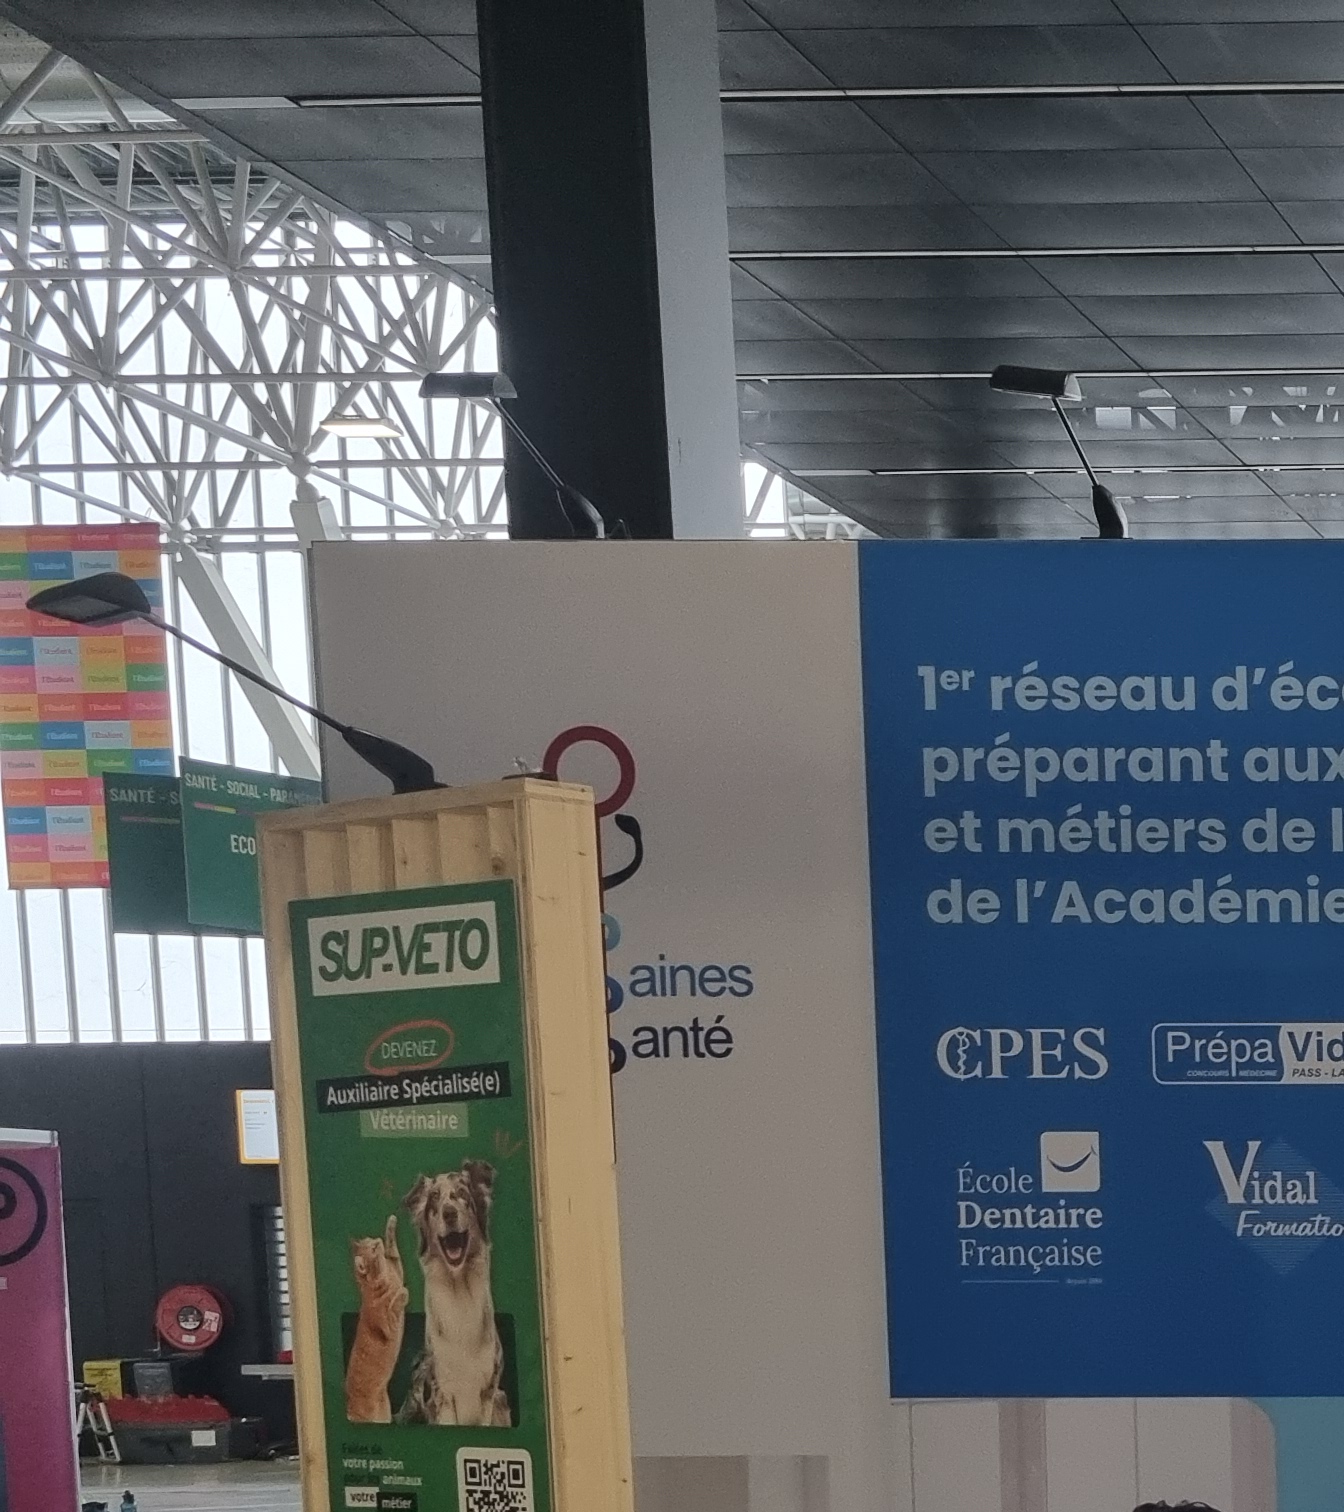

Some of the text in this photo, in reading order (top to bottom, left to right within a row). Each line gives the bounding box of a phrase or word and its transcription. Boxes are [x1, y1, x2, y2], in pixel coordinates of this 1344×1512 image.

[917, 665, 975, 710] 1er
[991, 660, 1195, 710] réseau
[185, 773, 218, 792] SANTÉ
[227, 781, 260, 799] SOCIAL
[923, 732, 1228, 797] préparant
[924, 810, 982, 853] et
[998, 803, 1227, 853] métiers
[1242, 808, 1315, 853] de
[926, 879, 1000, 924] de
[318, 917, 490, 982] SUP-VETO
[382, 1040, 438, 1059] DEVENEZ
[937, 1026, 1109, 1080] CPES
[1167, 1030, 1275, 1077] Prépa
[327, 1071, 500, 1106] Auxiliaire Spécialisé(e)
[957, 1162, 1033, 1194] École
[1203, 1141, 1318, 1205] Vidal
[957, 1199, 1103, 1229] Dentaire
[959, 1238, 1103, 1274] Française
[369, 1458, 404, 1472] passion
